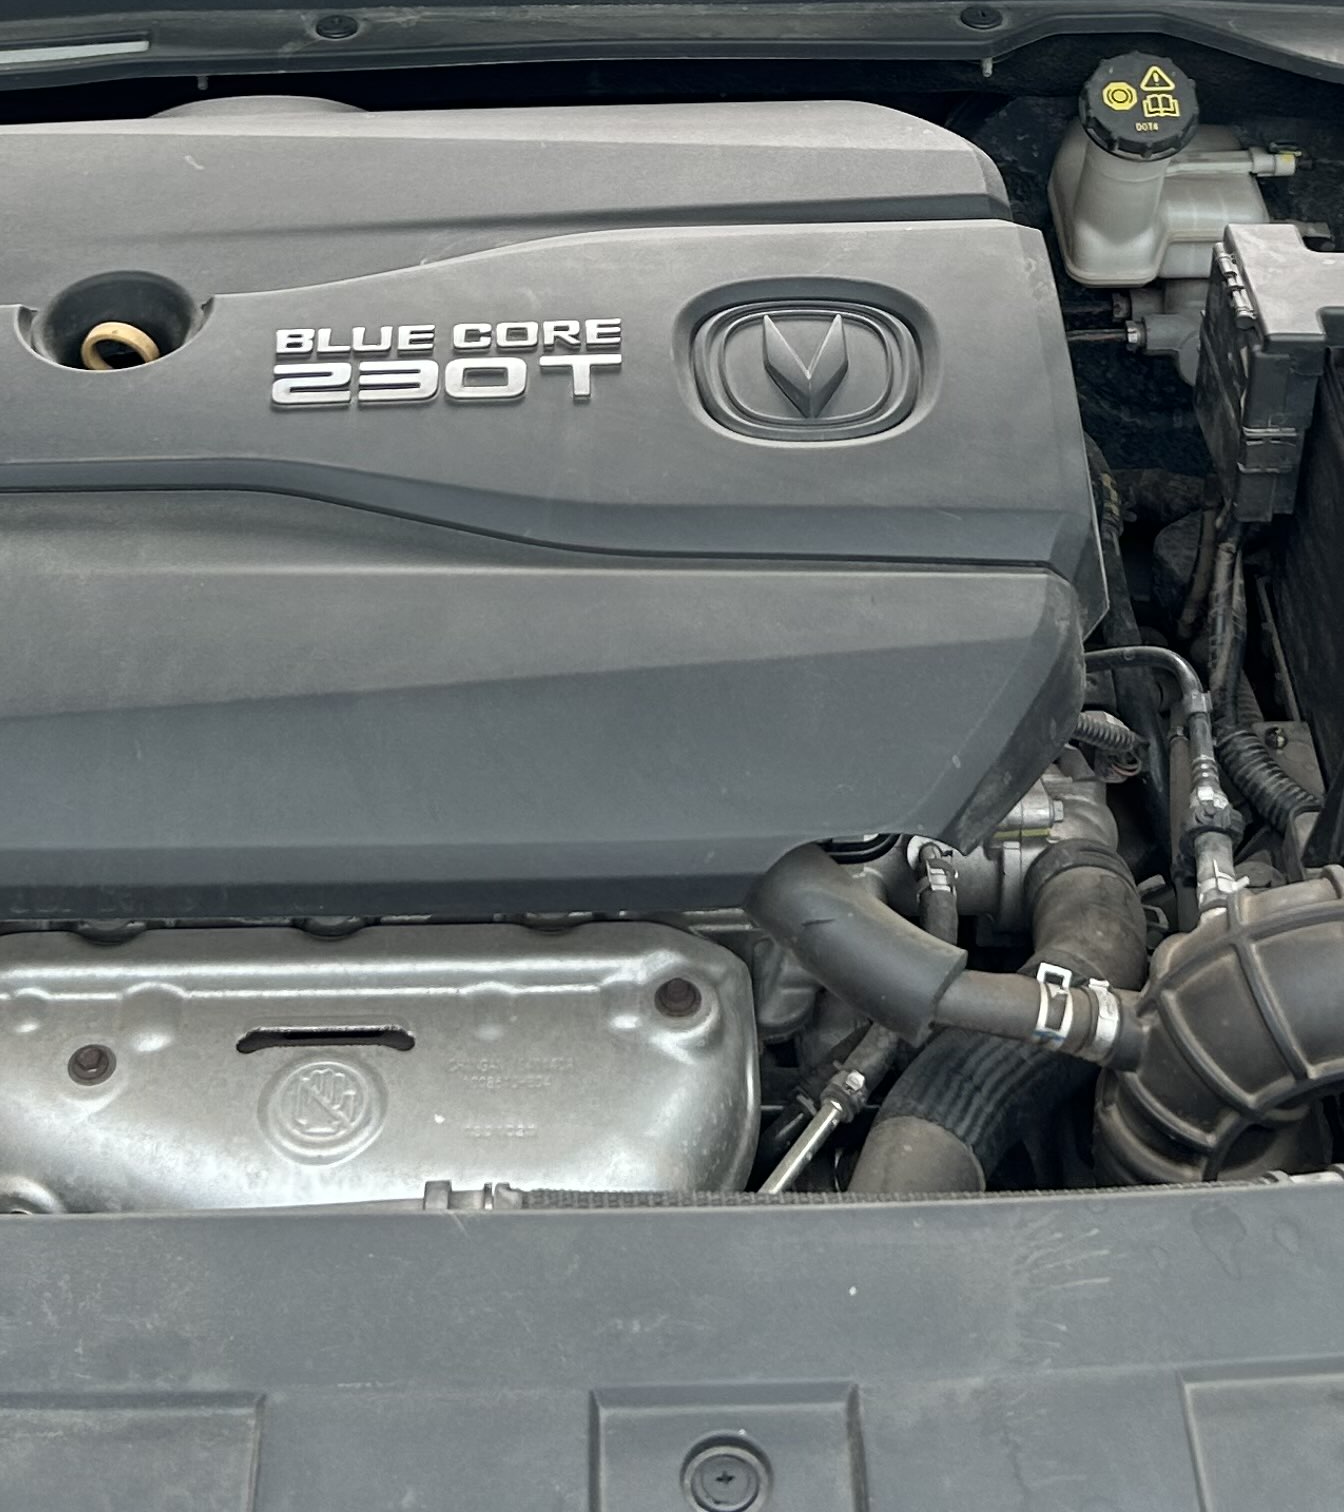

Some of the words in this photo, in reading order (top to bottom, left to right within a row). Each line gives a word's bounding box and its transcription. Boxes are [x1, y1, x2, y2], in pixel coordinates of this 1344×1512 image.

[275, 324, 436, 355] BLUE
[453, 318, 622, 350] CORE
[271, 353, 622, 407] 230T
